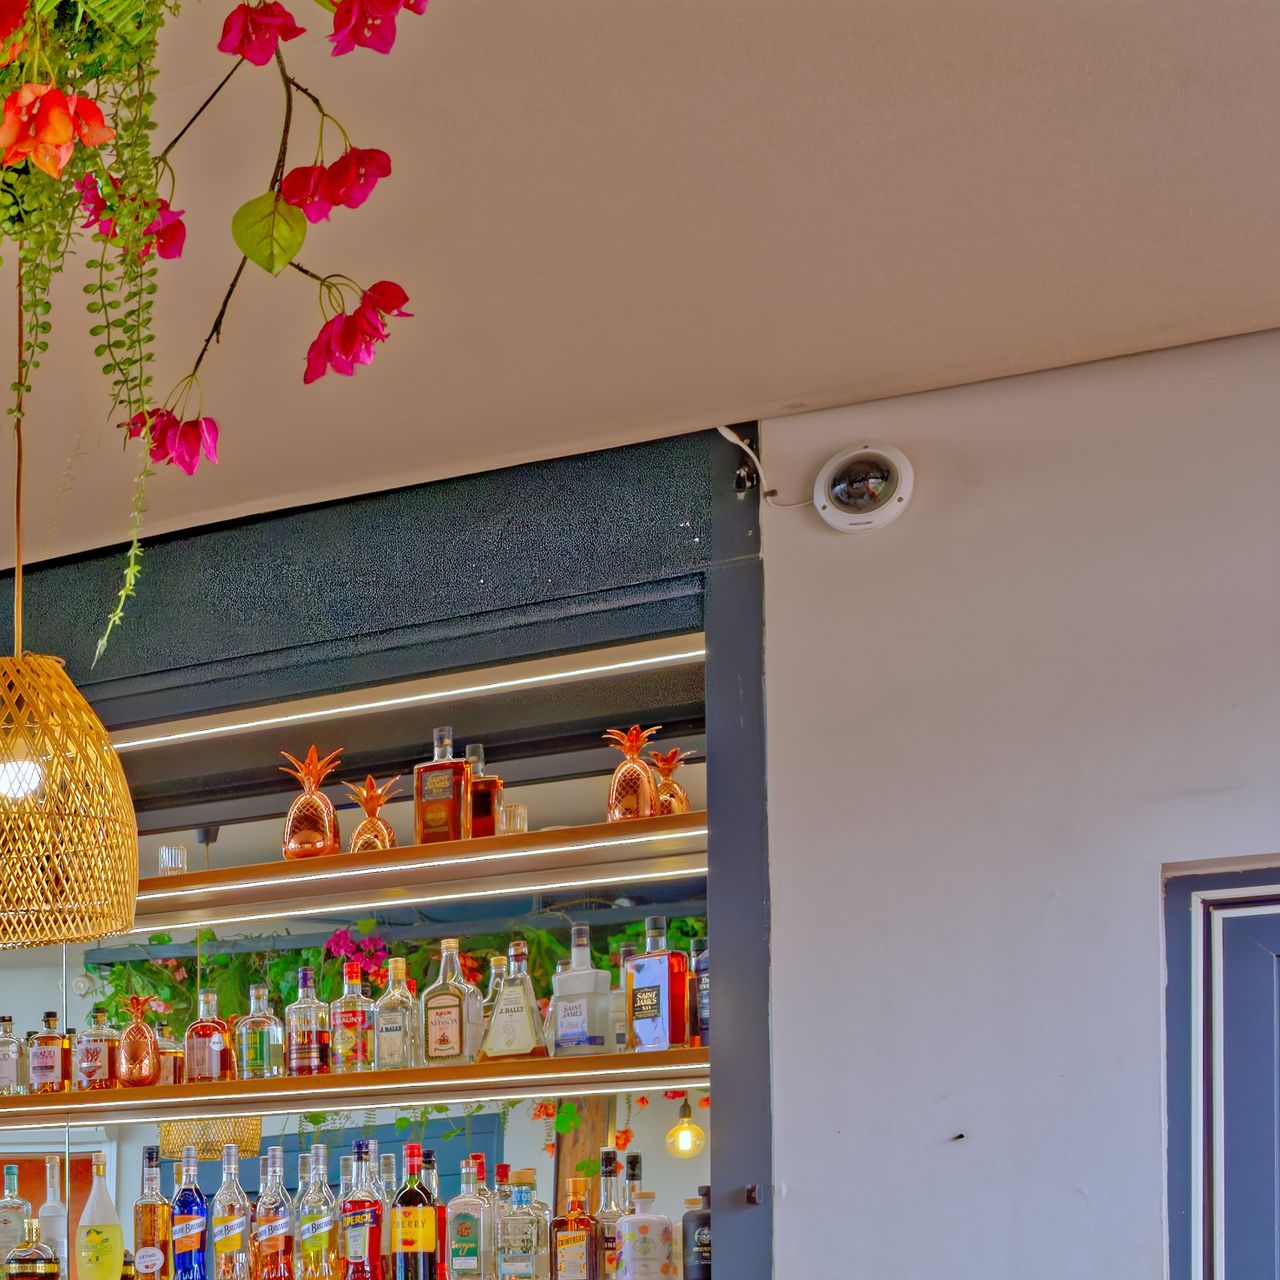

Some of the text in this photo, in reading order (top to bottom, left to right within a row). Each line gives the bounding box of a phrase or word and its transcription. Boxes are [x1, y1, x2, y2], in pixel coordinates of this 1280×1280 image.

[636, 990, 657, 999] SAINT
[634, 997, 657, 1008] JAMES
[563, 1004, 582, 1012] SAINT
[562, 1010, 583, 1019] JAMES
[343, 1213, 373, 1227] APEROL
[311, 1218, 332, 1233] BRIZARD
